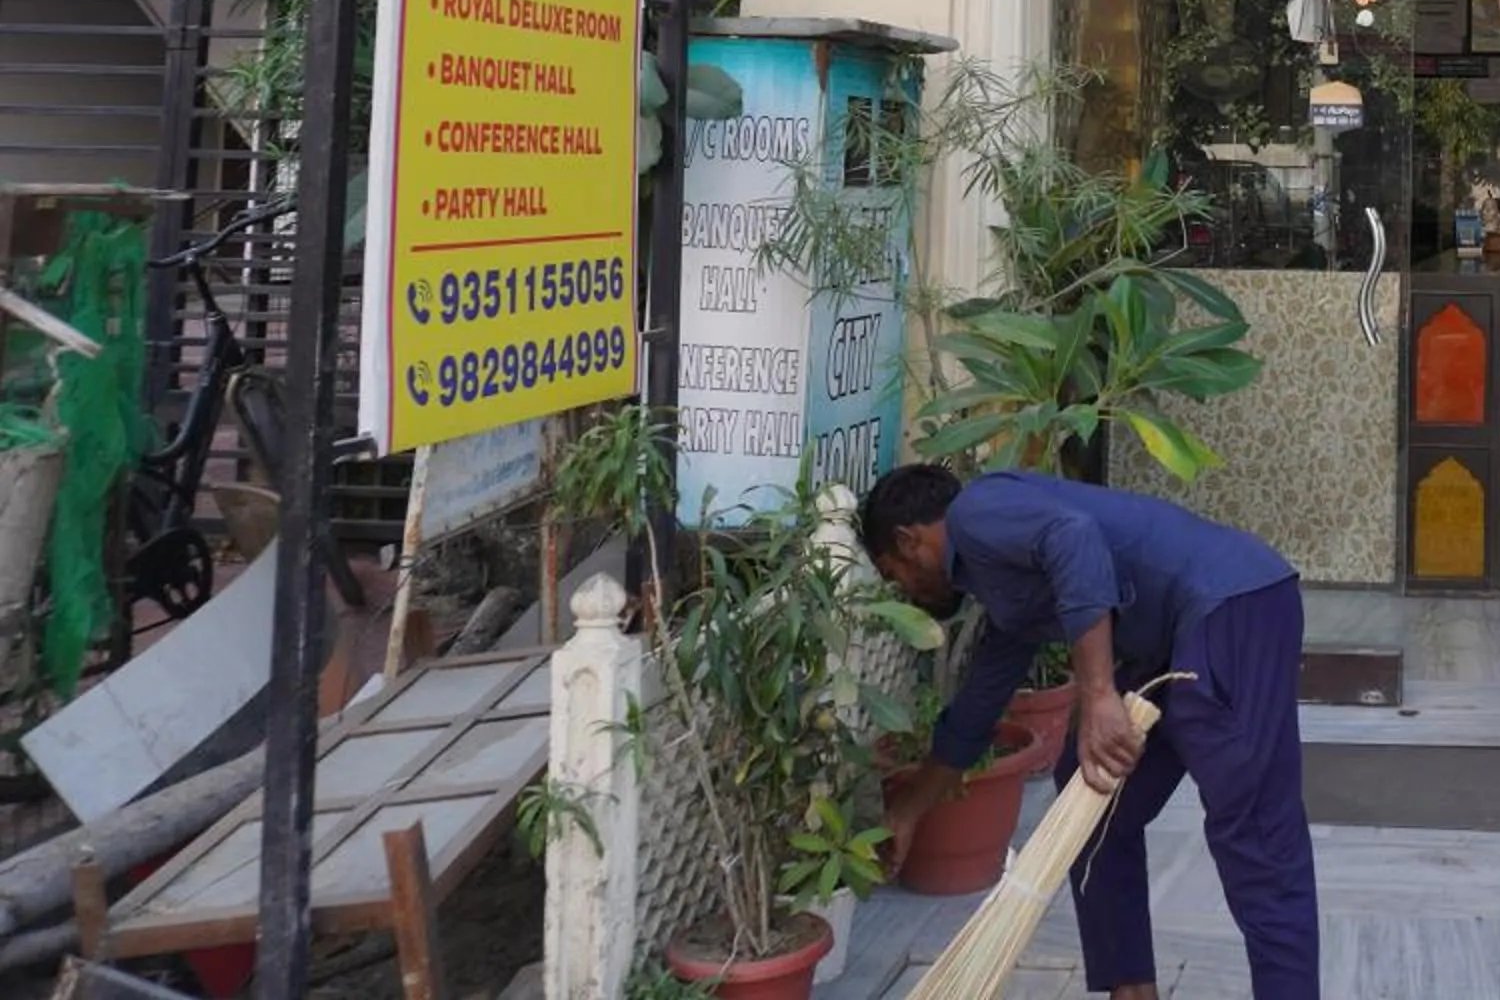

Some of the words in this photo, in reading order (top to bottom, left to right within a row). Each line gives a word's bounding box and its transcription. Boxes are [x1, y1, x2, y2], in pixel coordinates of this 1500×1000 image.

[576, 9, 622, 42] ROOM
[440, 53, 532, 92] BANQUET
[535, 63, 576, 95] HALL
[437, 121, 560, 155] CONFERENCE
[563, 127, 603, 155] HALL
[722, 115, 810, 162] ROOMS
[434, 188, 500, 221] PARTY
[503, 187, 548, 217] HALL
[440, 257, 624, 325] 9351155056
[700, 265, 757, 313] HALL
[439, 325, 625, 408] 9829844999
[680, 343, 799, 395] NFERENCE
[825, 312, 882, 401] CITY
[679, 407, 739, 455] ARTY
[743, 410, 800, 459] HALL
[811, 416, 881, 500] HOME
